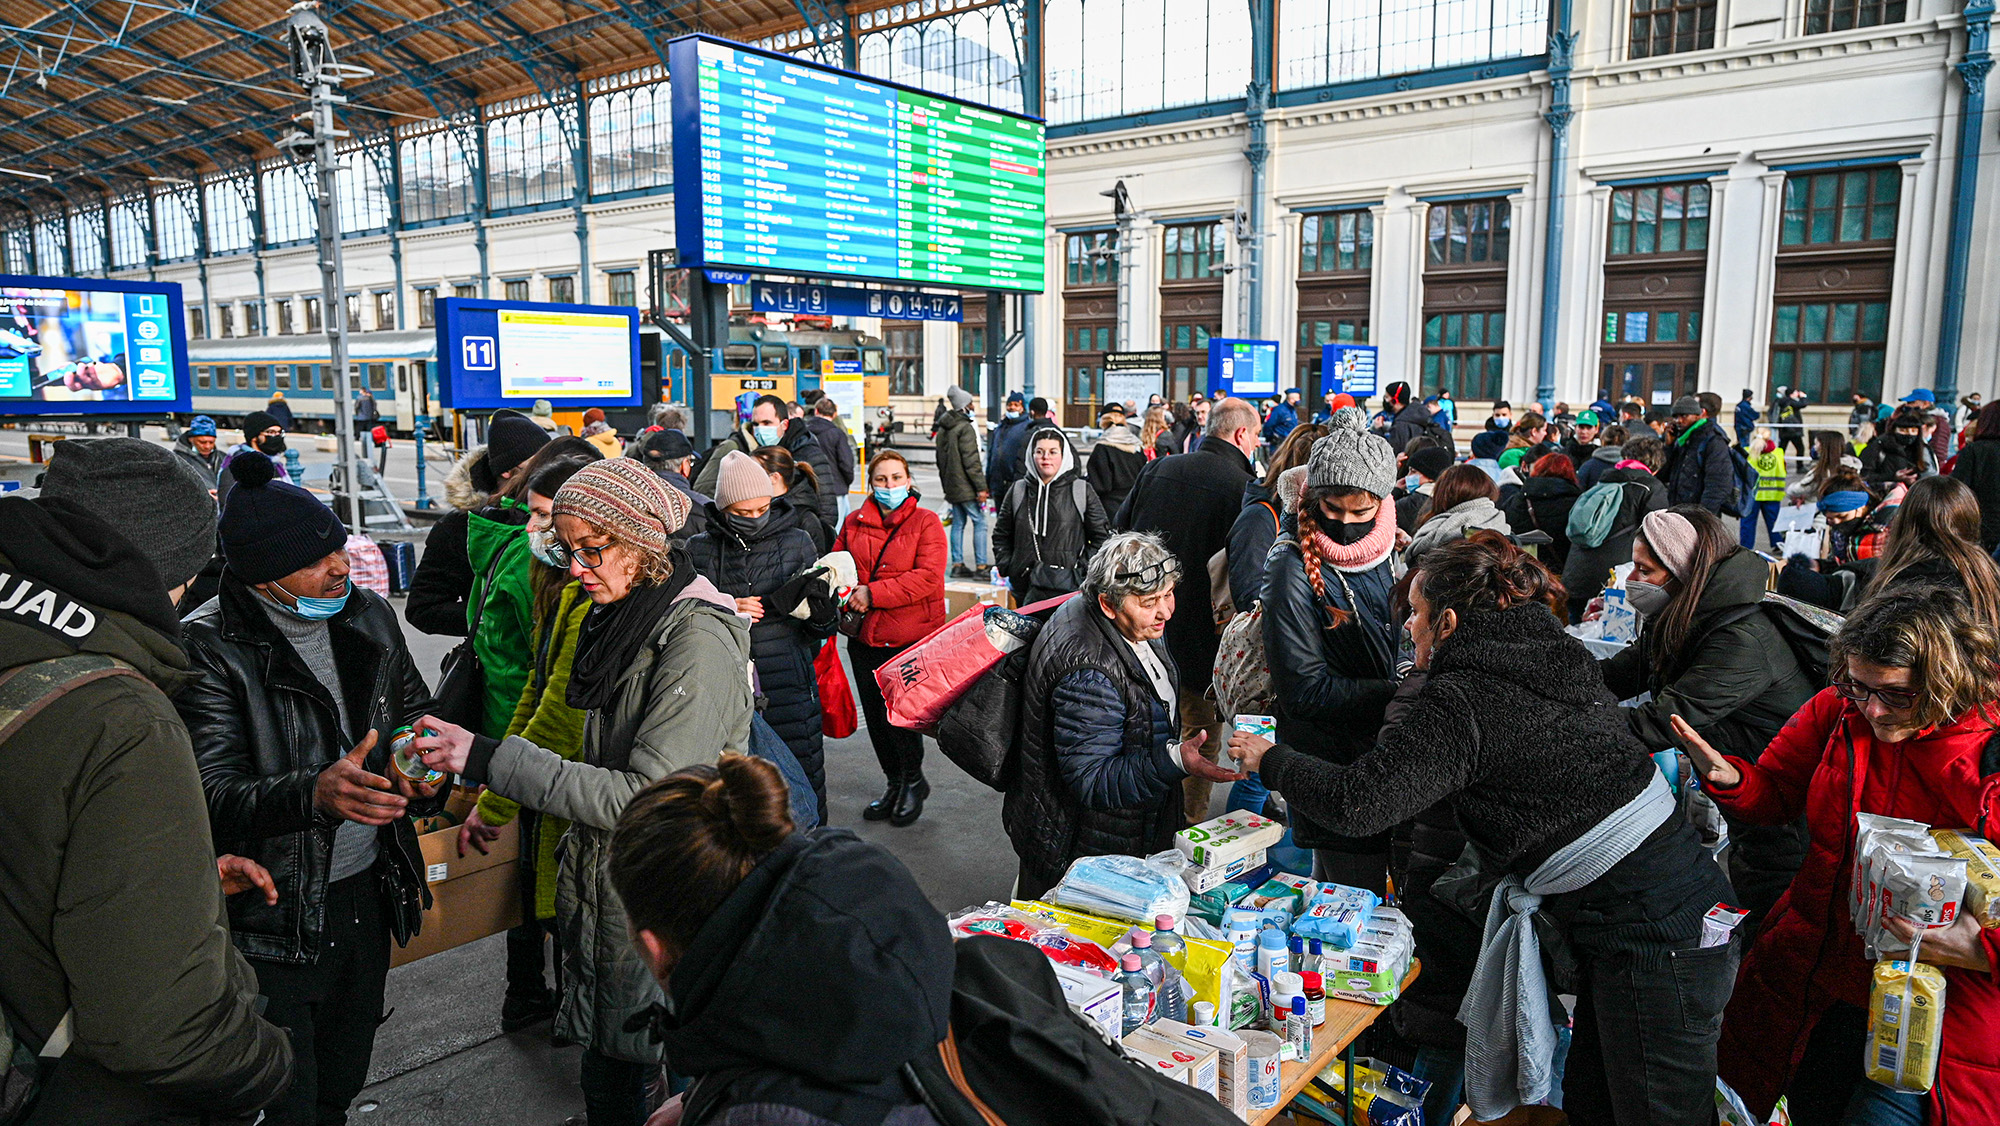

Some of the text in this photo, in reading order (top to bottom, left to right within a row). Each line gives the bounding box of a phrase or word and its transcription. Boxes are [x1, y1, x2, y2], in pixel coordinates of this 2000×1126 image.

[711, 271, 744, 281] INFOPIX
[786, 288, 792, 303] 1
[812, 289, 821, 306] 9
[909, 296, 922, 311] 14
[932, 298, 944, 312] 17
[466, 342, 490, 364] 11
[900, 657, 924, 686] kik
